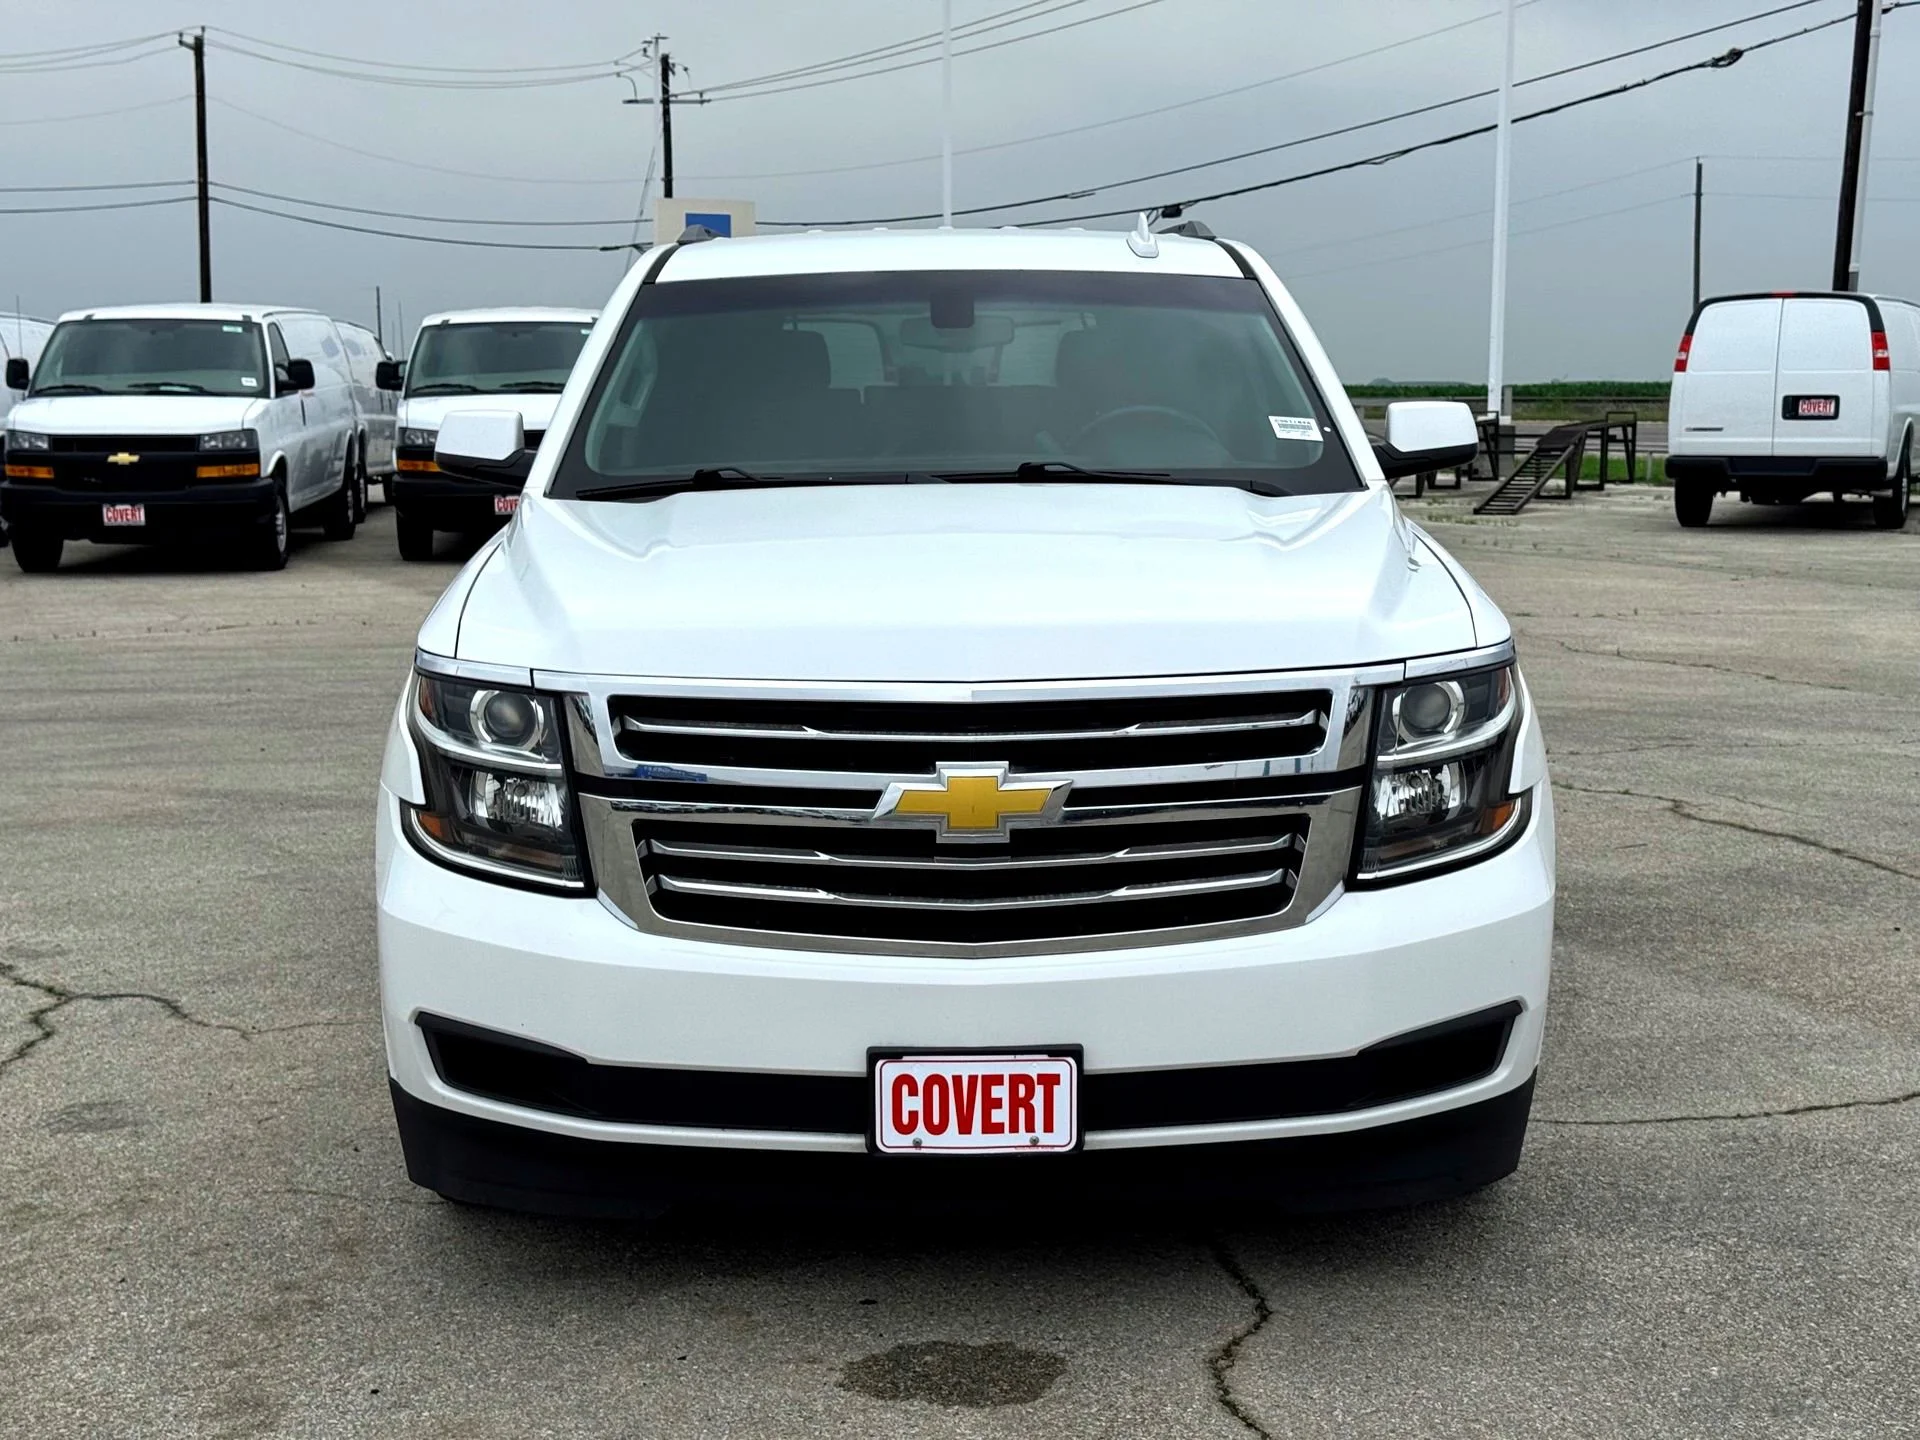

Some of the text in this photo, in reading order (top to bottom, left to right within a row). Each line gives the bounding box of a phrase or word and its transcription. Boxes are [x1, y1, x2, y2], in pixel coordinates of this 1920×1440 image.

[1800, 400, 1833, 413] COVERT
[106, 507, 142, 522] COVERT
[892, 1073, 1061, 1136] COVERT
